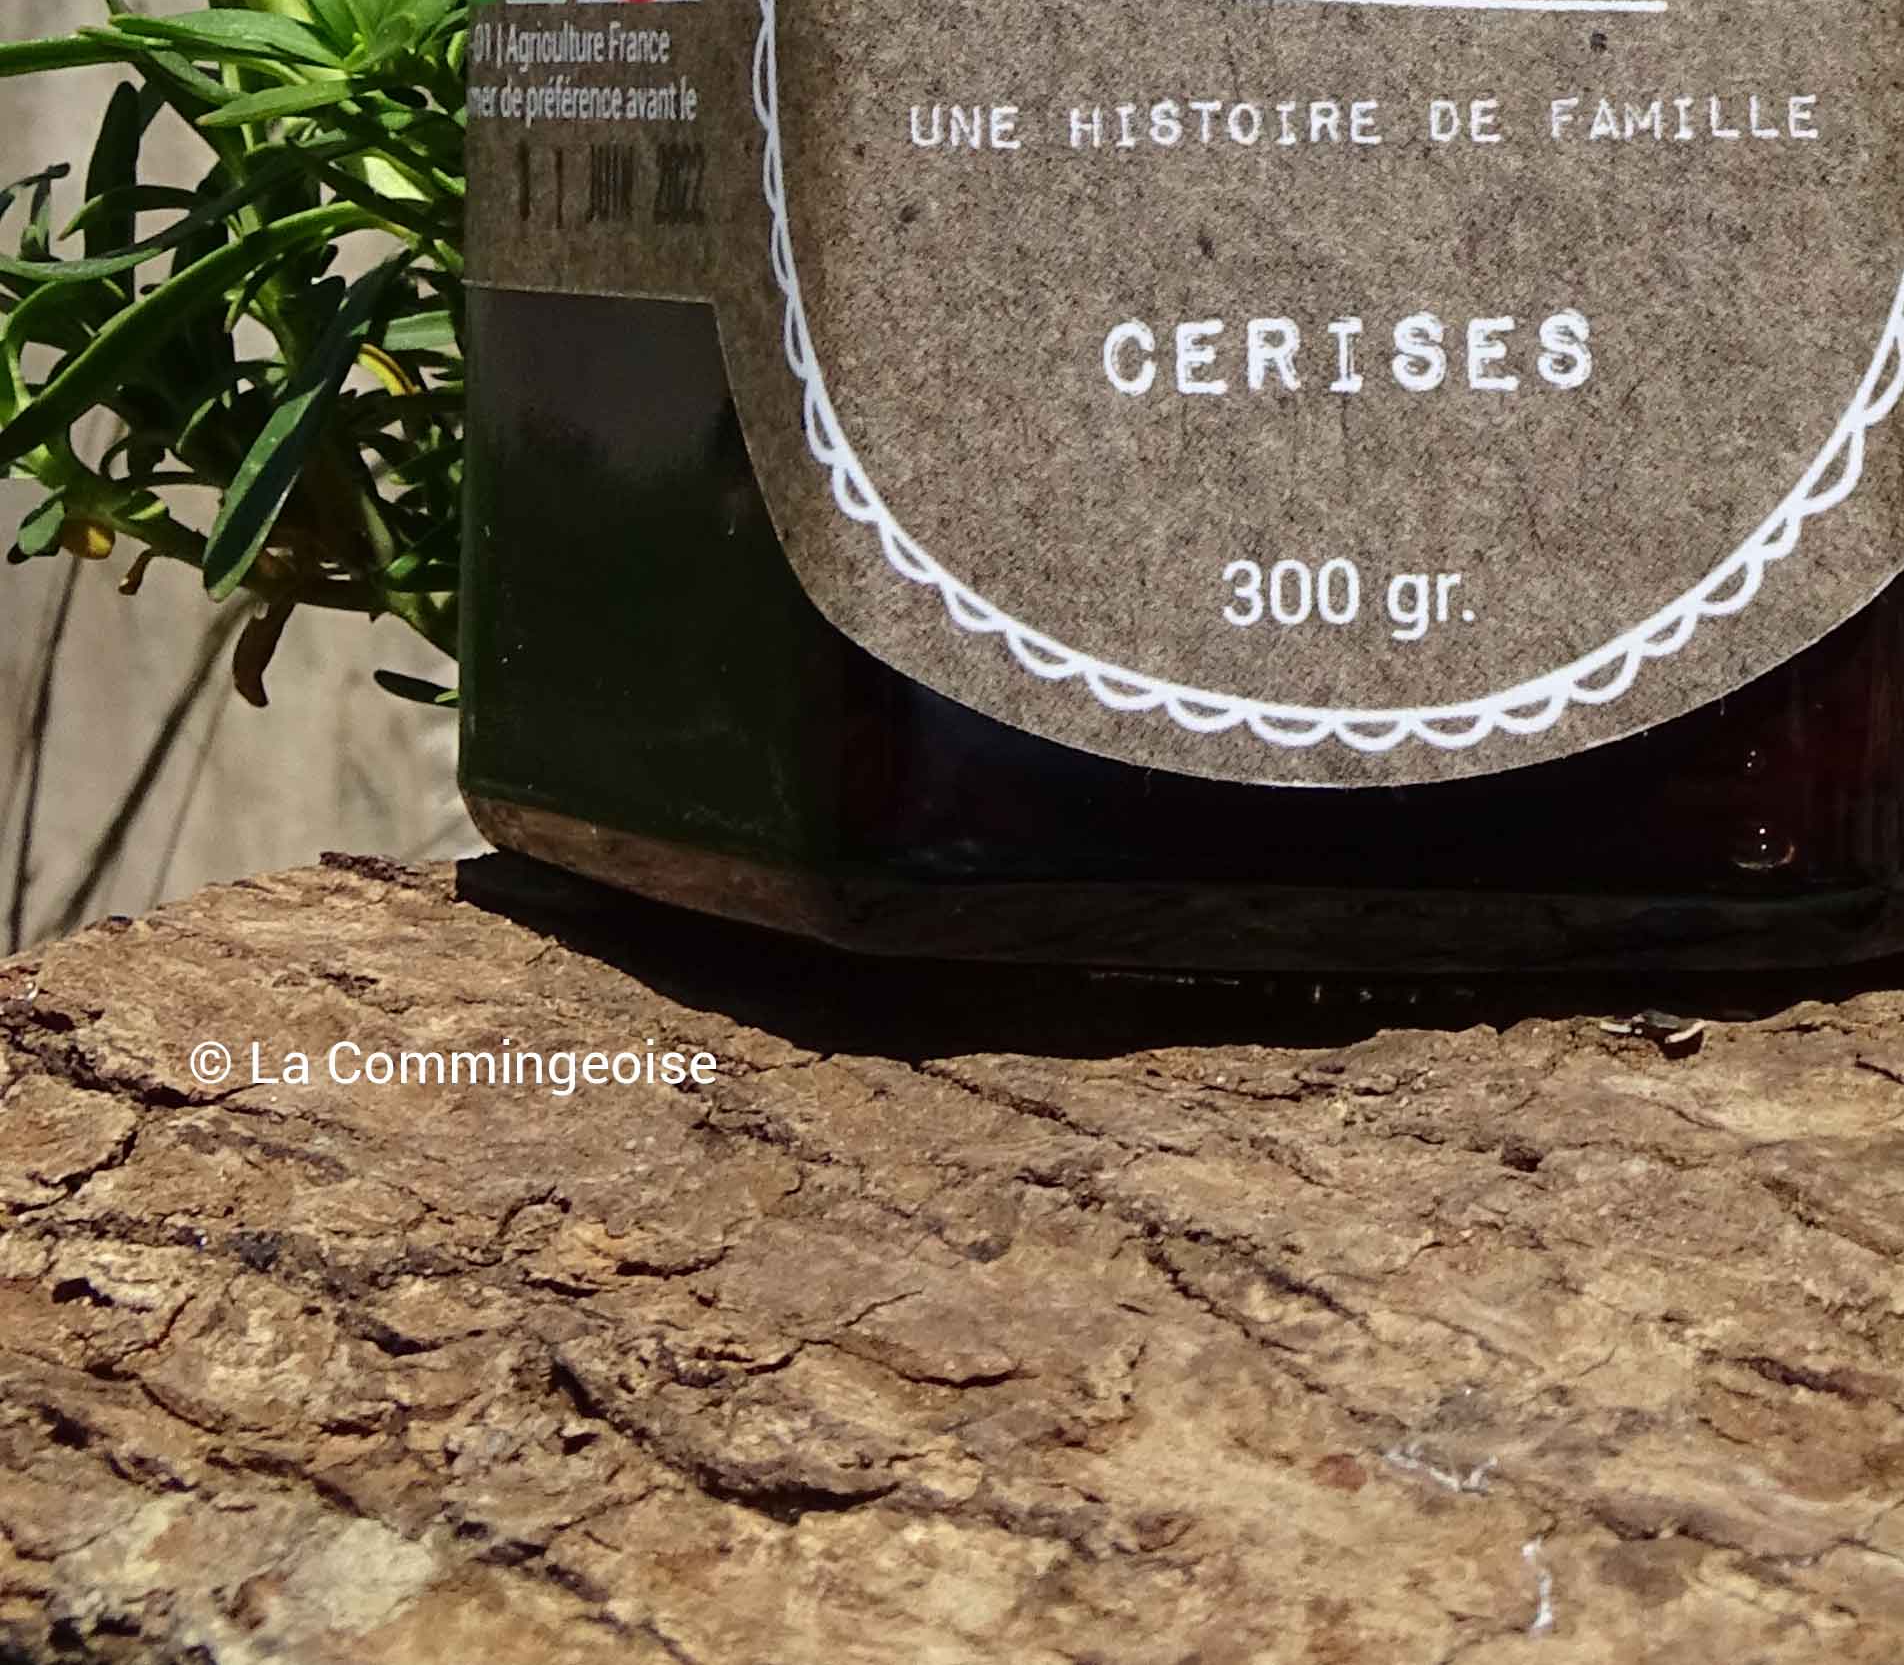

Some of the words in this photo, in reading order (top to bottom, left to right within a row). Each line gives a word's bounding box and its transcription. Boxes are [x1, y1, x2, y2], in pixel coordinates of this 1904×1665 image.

[506, 20, 604, 73] Agriculture
[608, 21, 671, 64] France
[500, 74, 523, 118] de
[525, 74, 622, 129] préférence
[625, 82, 677, 119] avant
[680, 75, 698, 121] le
[909, 105, 1022, 151] UNE
[1069, 99, 1382, 149] HISTOIRE
[1429, 99, 1502, 144] DE
[1548, 94, 1820, 142] FAMILLE
[1103, 309, 1593, 395] CERISES
[1221, 558, 1360, 627] 300
[1387, 570, 1475, 641] gr.
